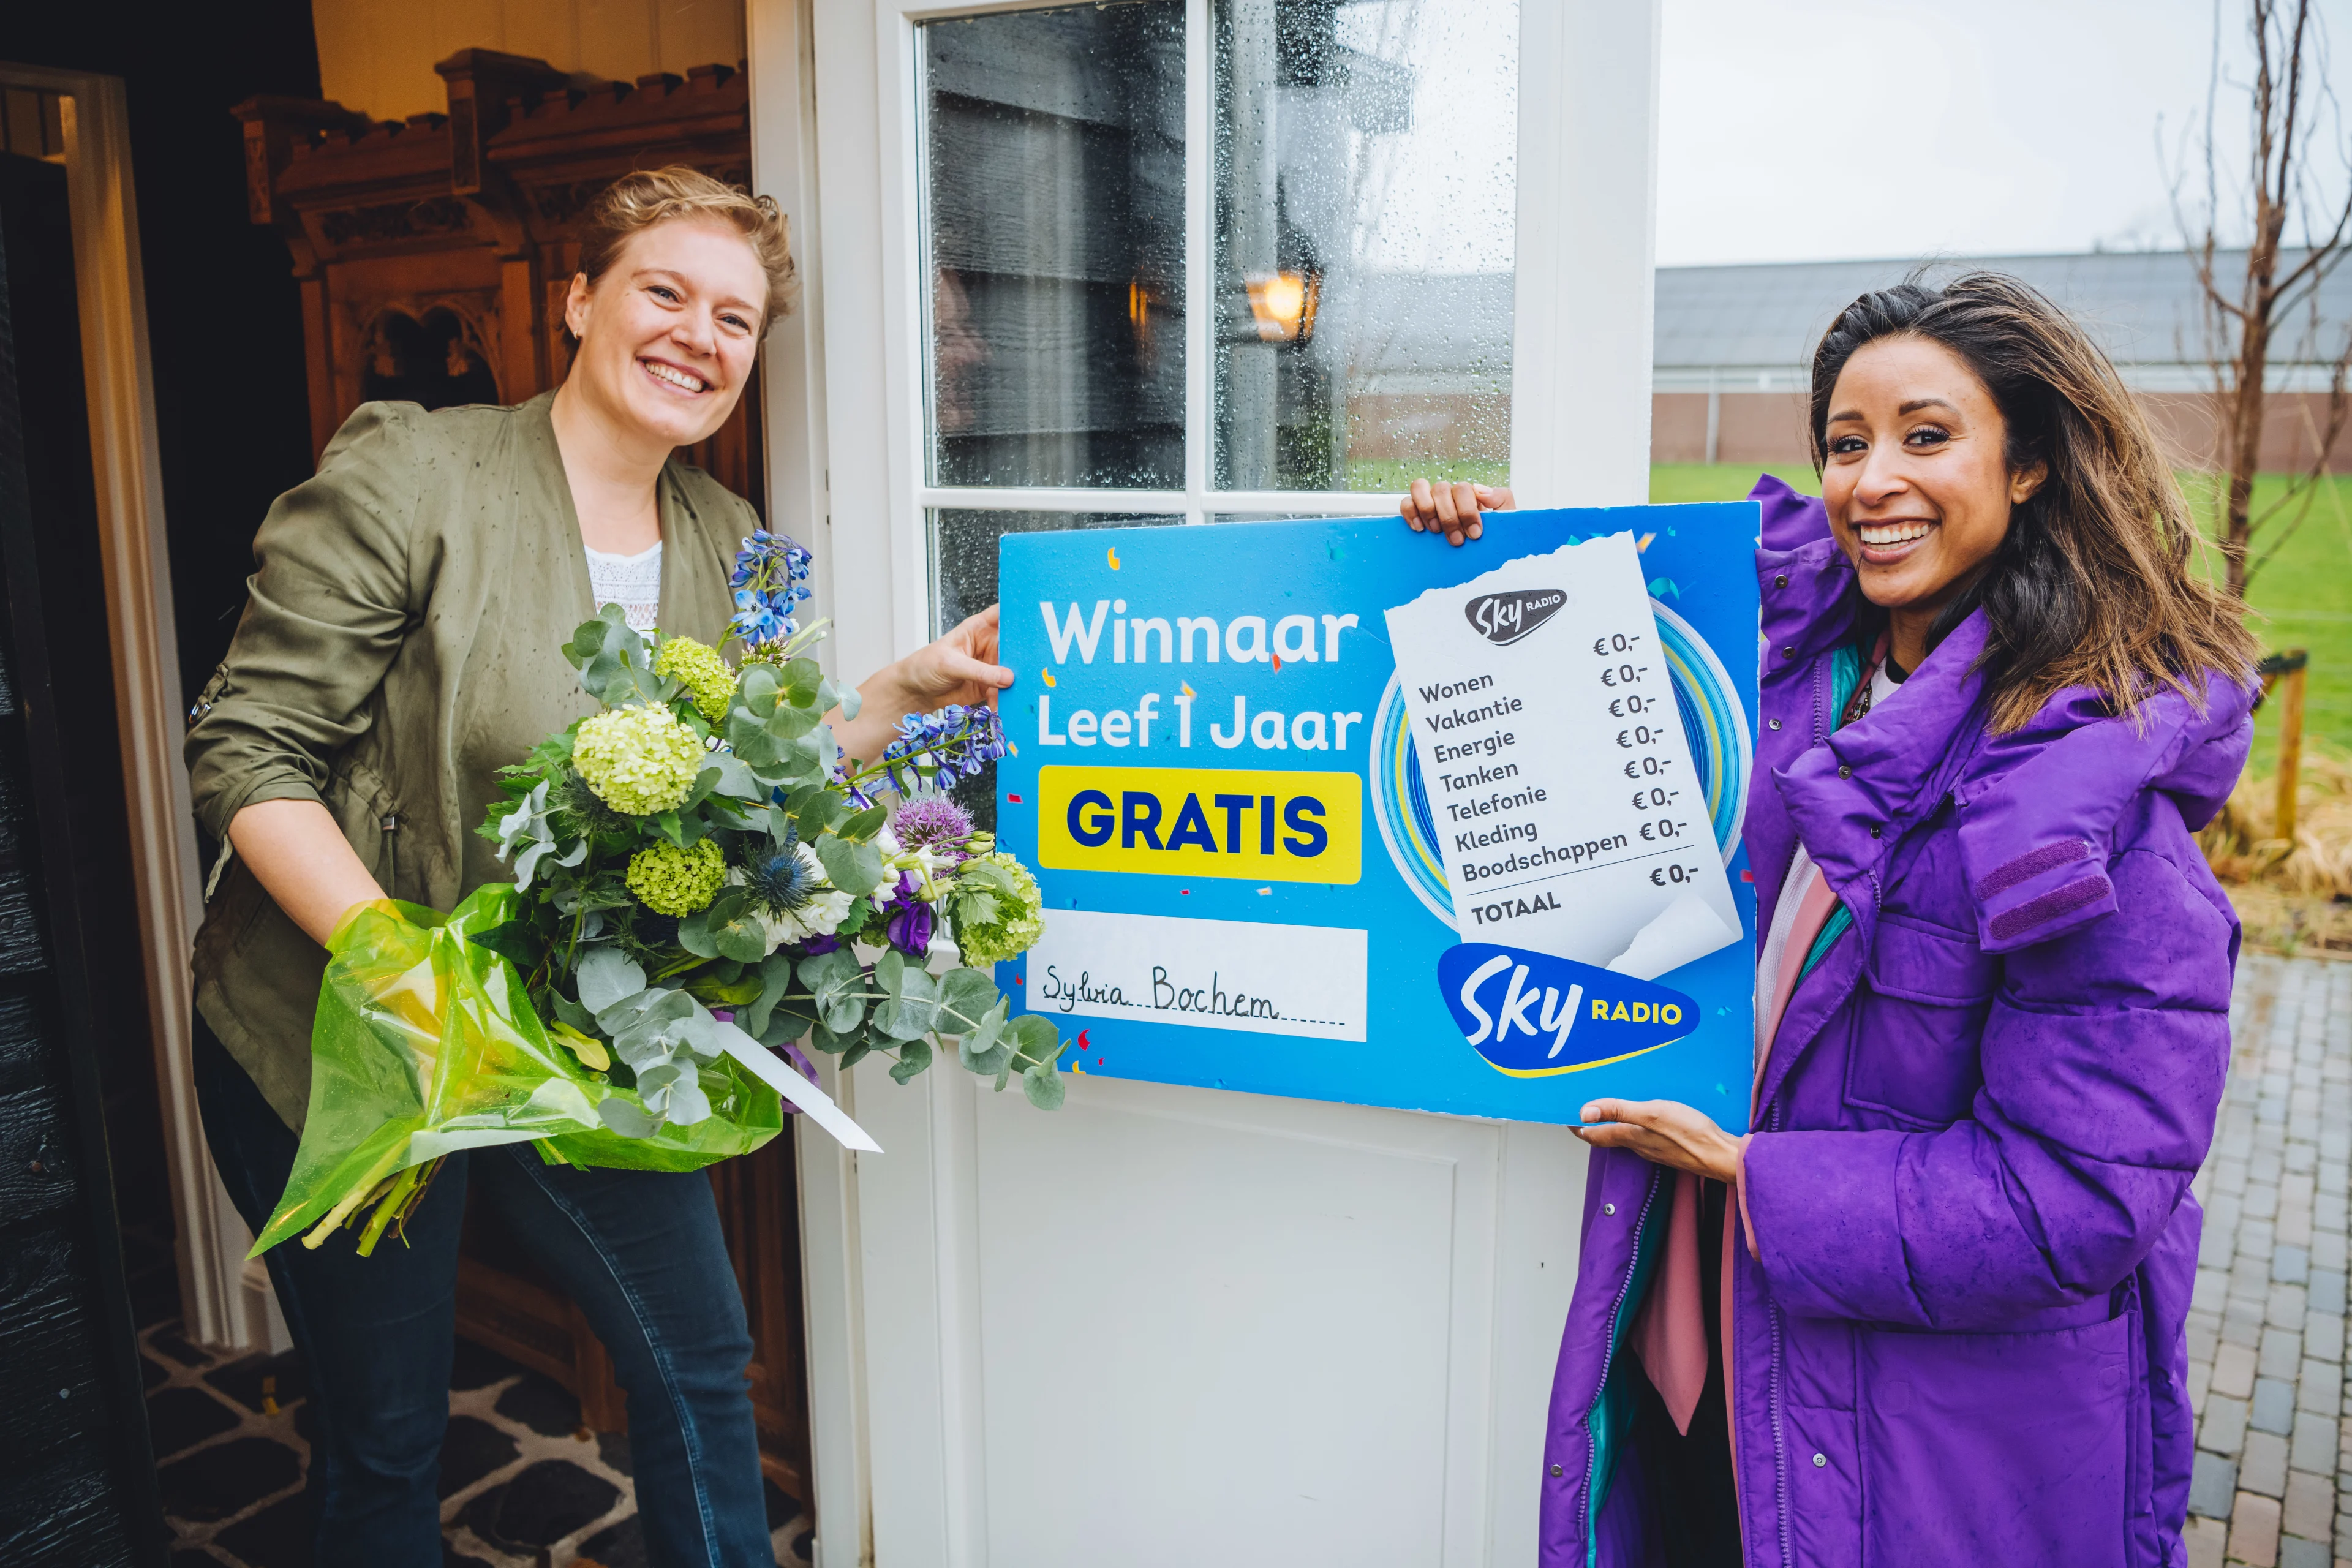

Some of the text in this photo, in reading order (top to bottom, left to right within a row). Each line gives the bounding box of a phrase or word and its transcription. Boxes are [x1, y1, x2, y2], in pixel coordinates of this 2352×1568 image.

[1039, 598, 1359, 665] Winnaar
[1475, 593, 1561, 638] Sky RADIO
[1419, 674, 1494, 704] Wonen
[1039, 692, 1363, 751] Leef 1 Jaar
[1425, 696, 1523, 733] Vakantie
[1434, 729, 1516, 764] Energie
[1439, 764, 1519, 793] Tanken
[1066, 789, 1329, 858] GRATIS
[1446, 785, 1547, 822] Telefonie
[1455, 818, 1538, 853] Kleding
[1462, 831, 1628, 883] Boodschappen
[1471, 891, 1562, 925] TOTAAL
[1043, 965, 1280, 1020] Sylvia Bochem
[1460, 954, 1683, 1059] Sky RADIO
